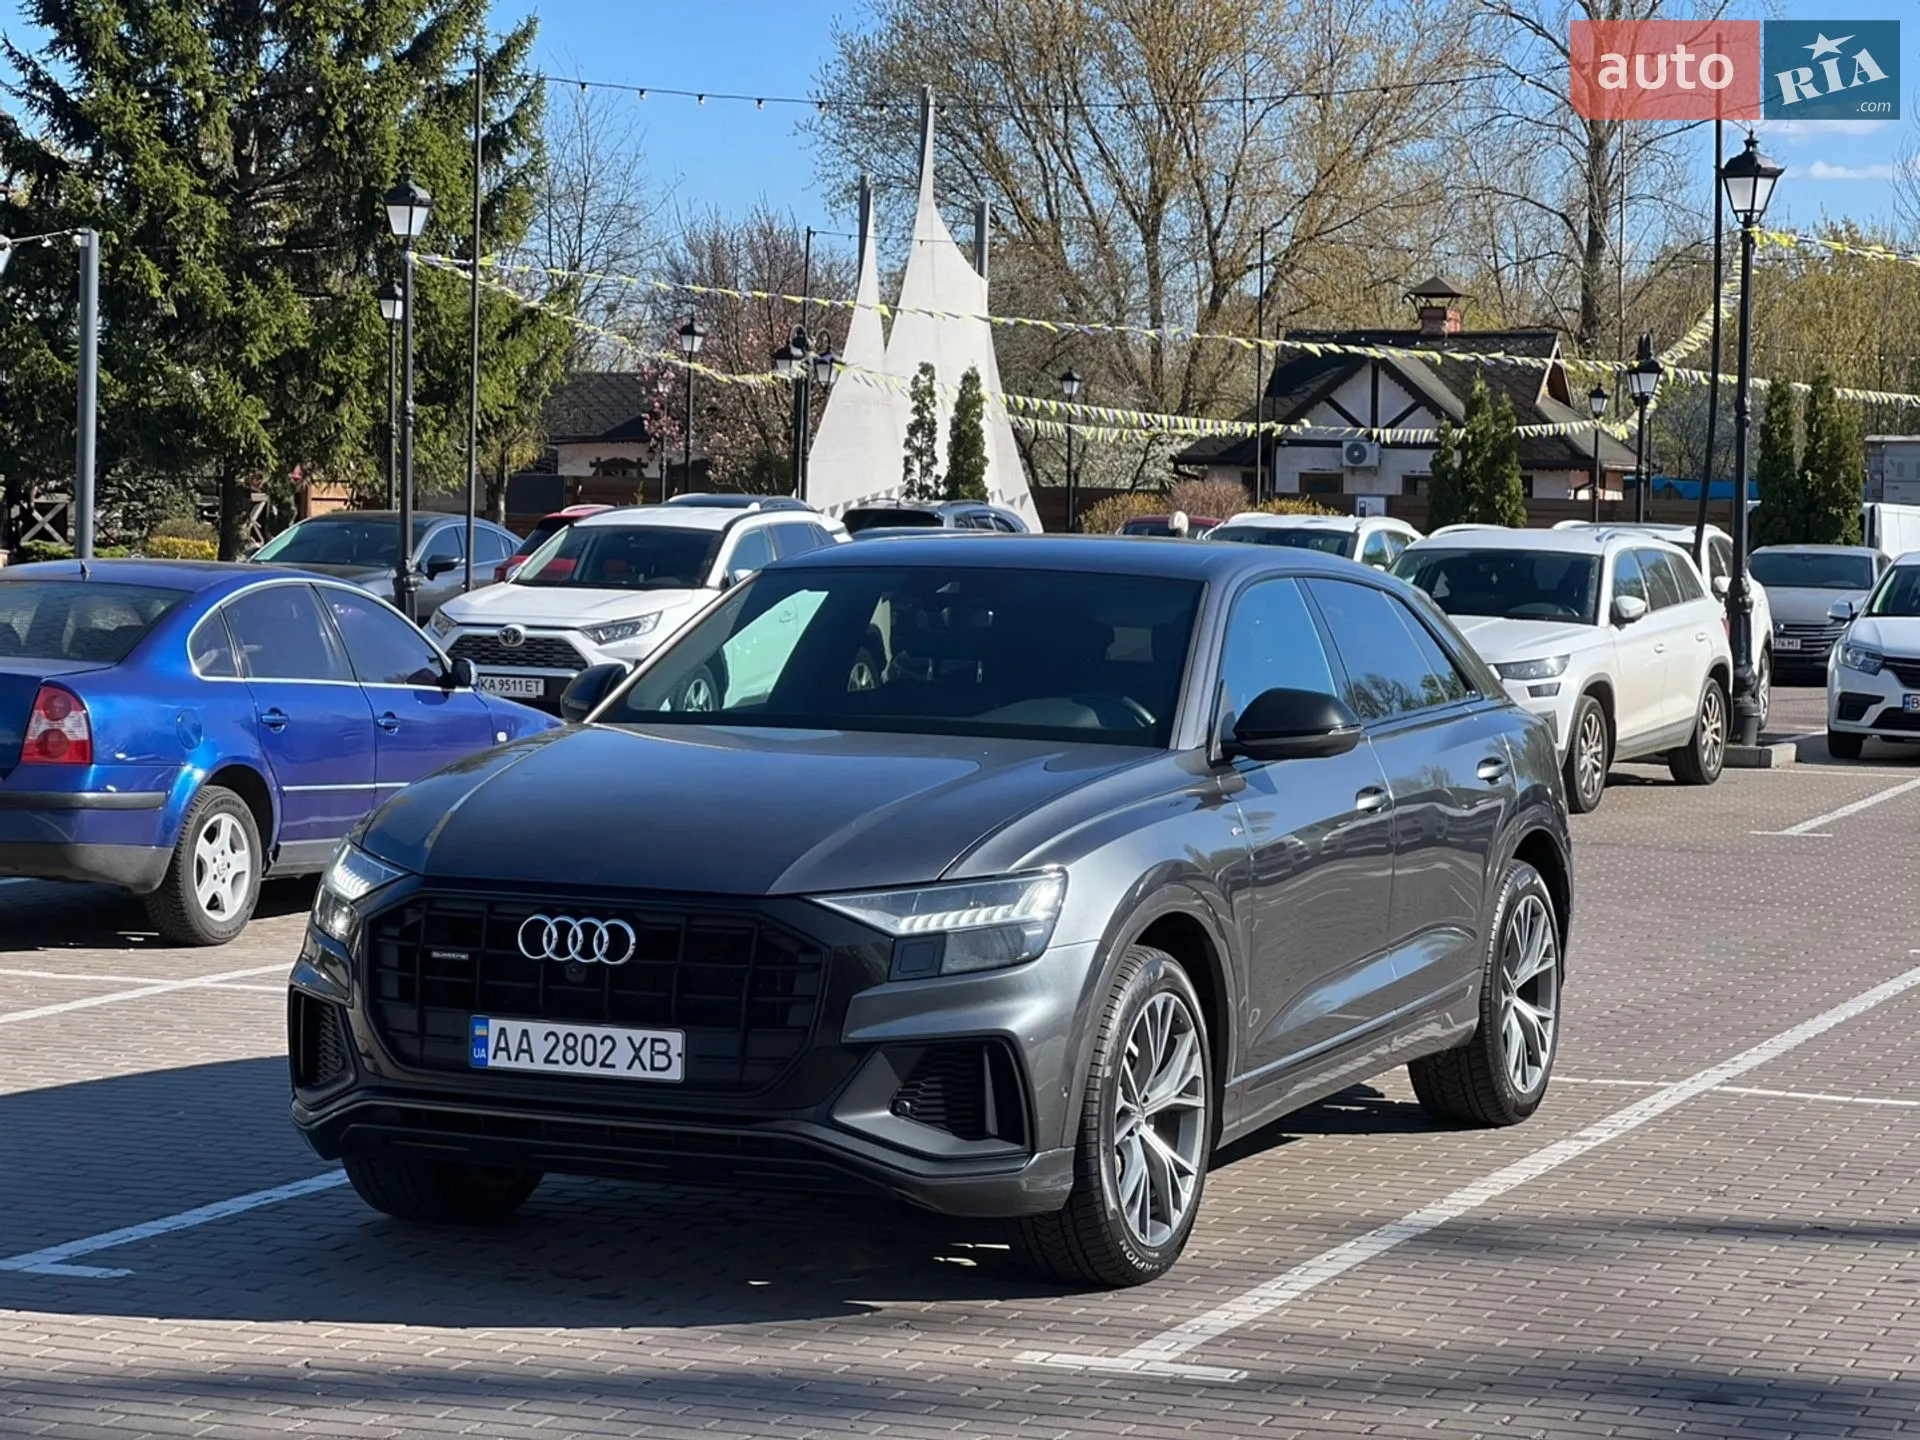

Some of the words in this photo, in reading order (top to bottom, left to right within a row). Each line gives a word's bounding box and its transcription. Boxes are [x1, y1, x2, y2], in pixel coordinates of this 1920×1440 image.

[480, 679, 496, 691] KA
[498, 679, 523, 692] 9511
[525, 680, 540, 692] ET
[474, 1048, 486, 1058] UA
[492, 1027, 534, 1063] AA
[543, 1031, 616, 1068] 2802
[626, 1036, 672, 1072] XB
